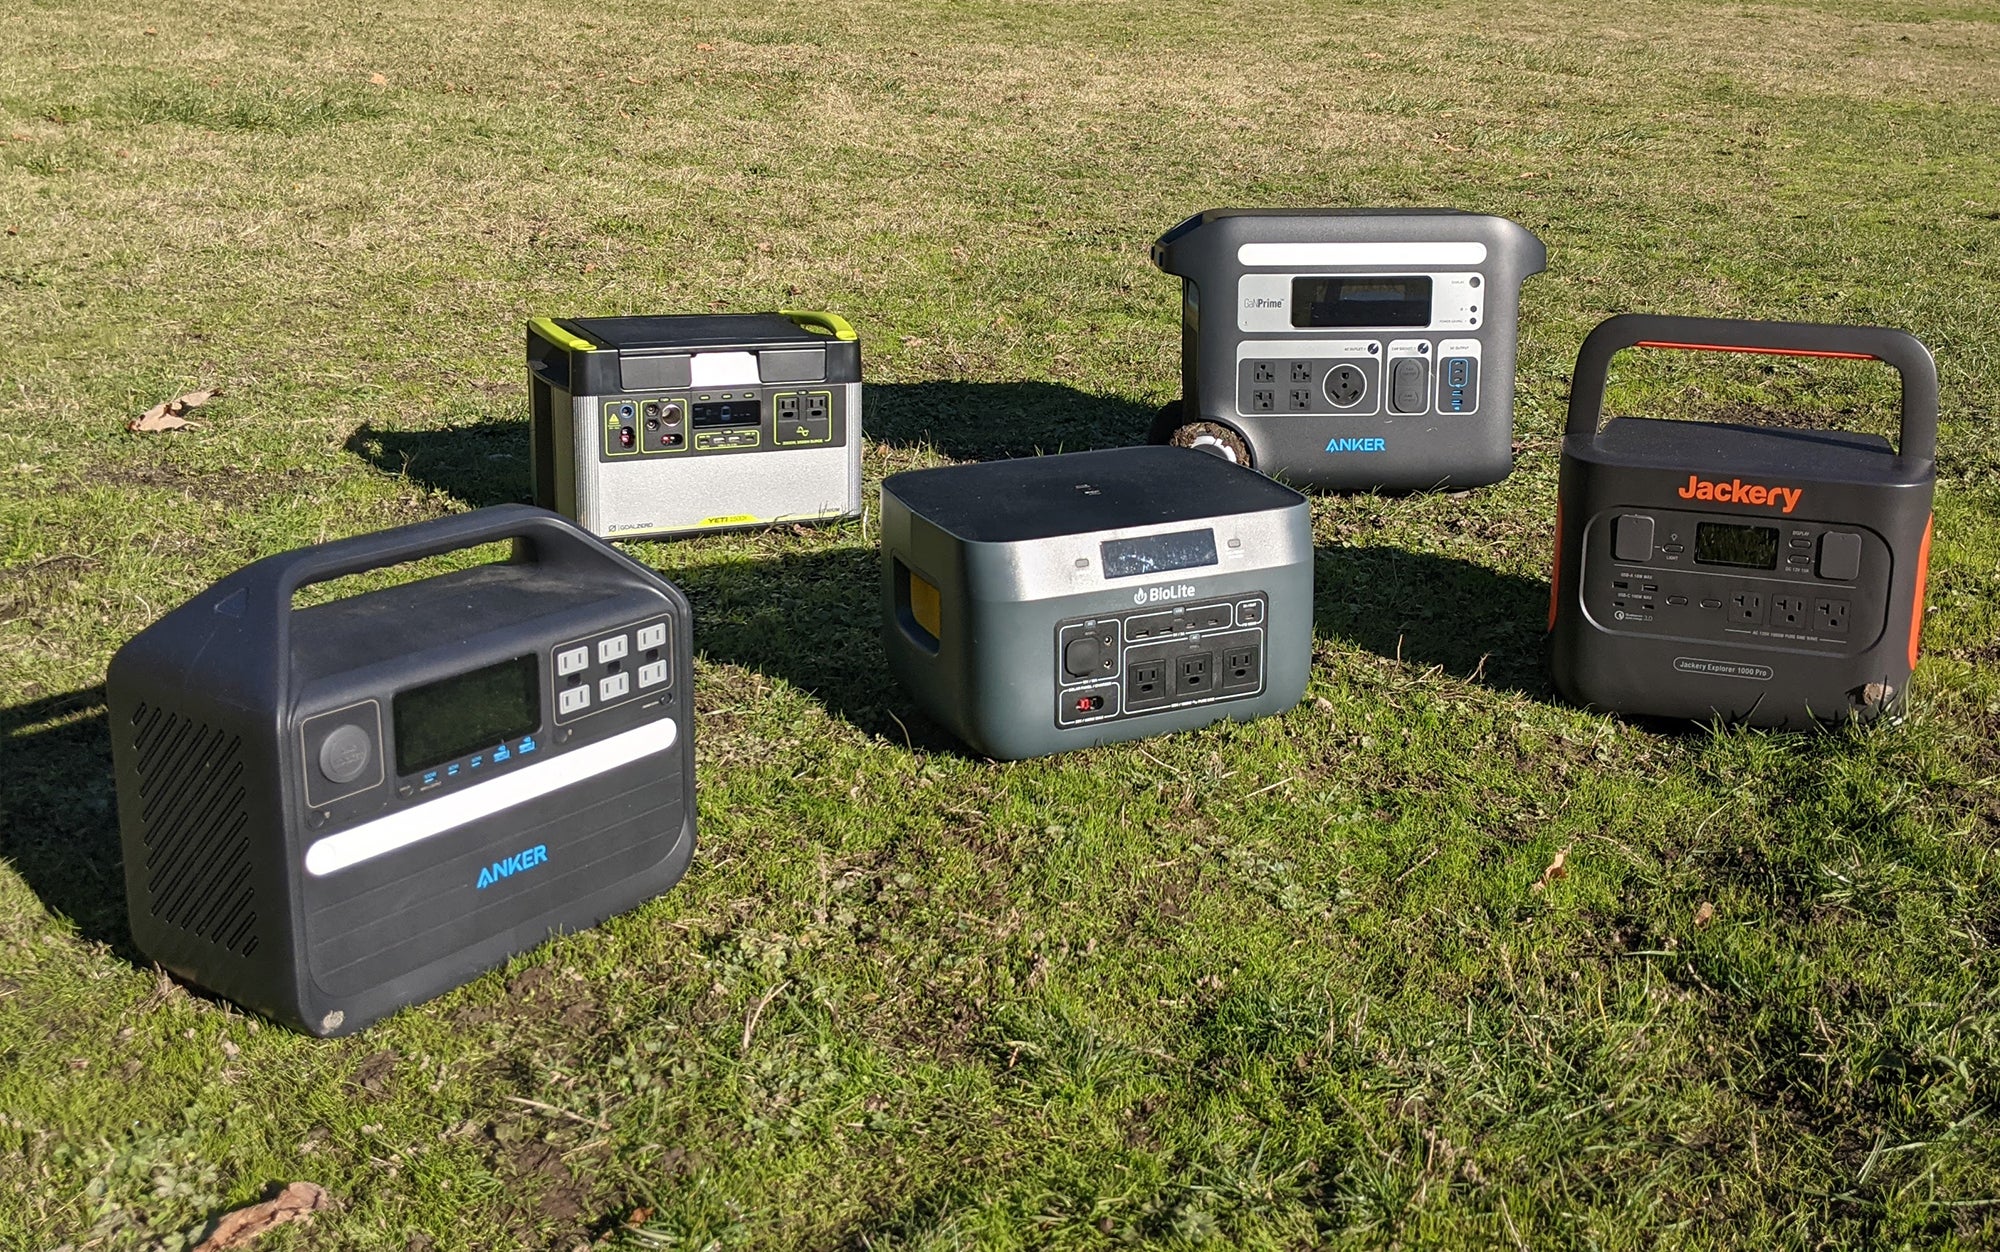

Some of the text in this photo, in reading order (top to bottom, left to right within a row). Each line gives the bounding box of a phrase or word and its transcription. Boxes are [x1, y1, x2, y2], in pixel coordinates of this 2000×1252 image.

[1325, 438, 1386, 453] ANKER
[1678, 475, 1802, 513] Jackery
[708, 516, 728, 524] YETI
[1149, 584, 1196, 602] BioLite
[1680, 661, 1767, 677] Jackery Explorer 1000 Pro
[476, 844, 549, 889] ANKER
